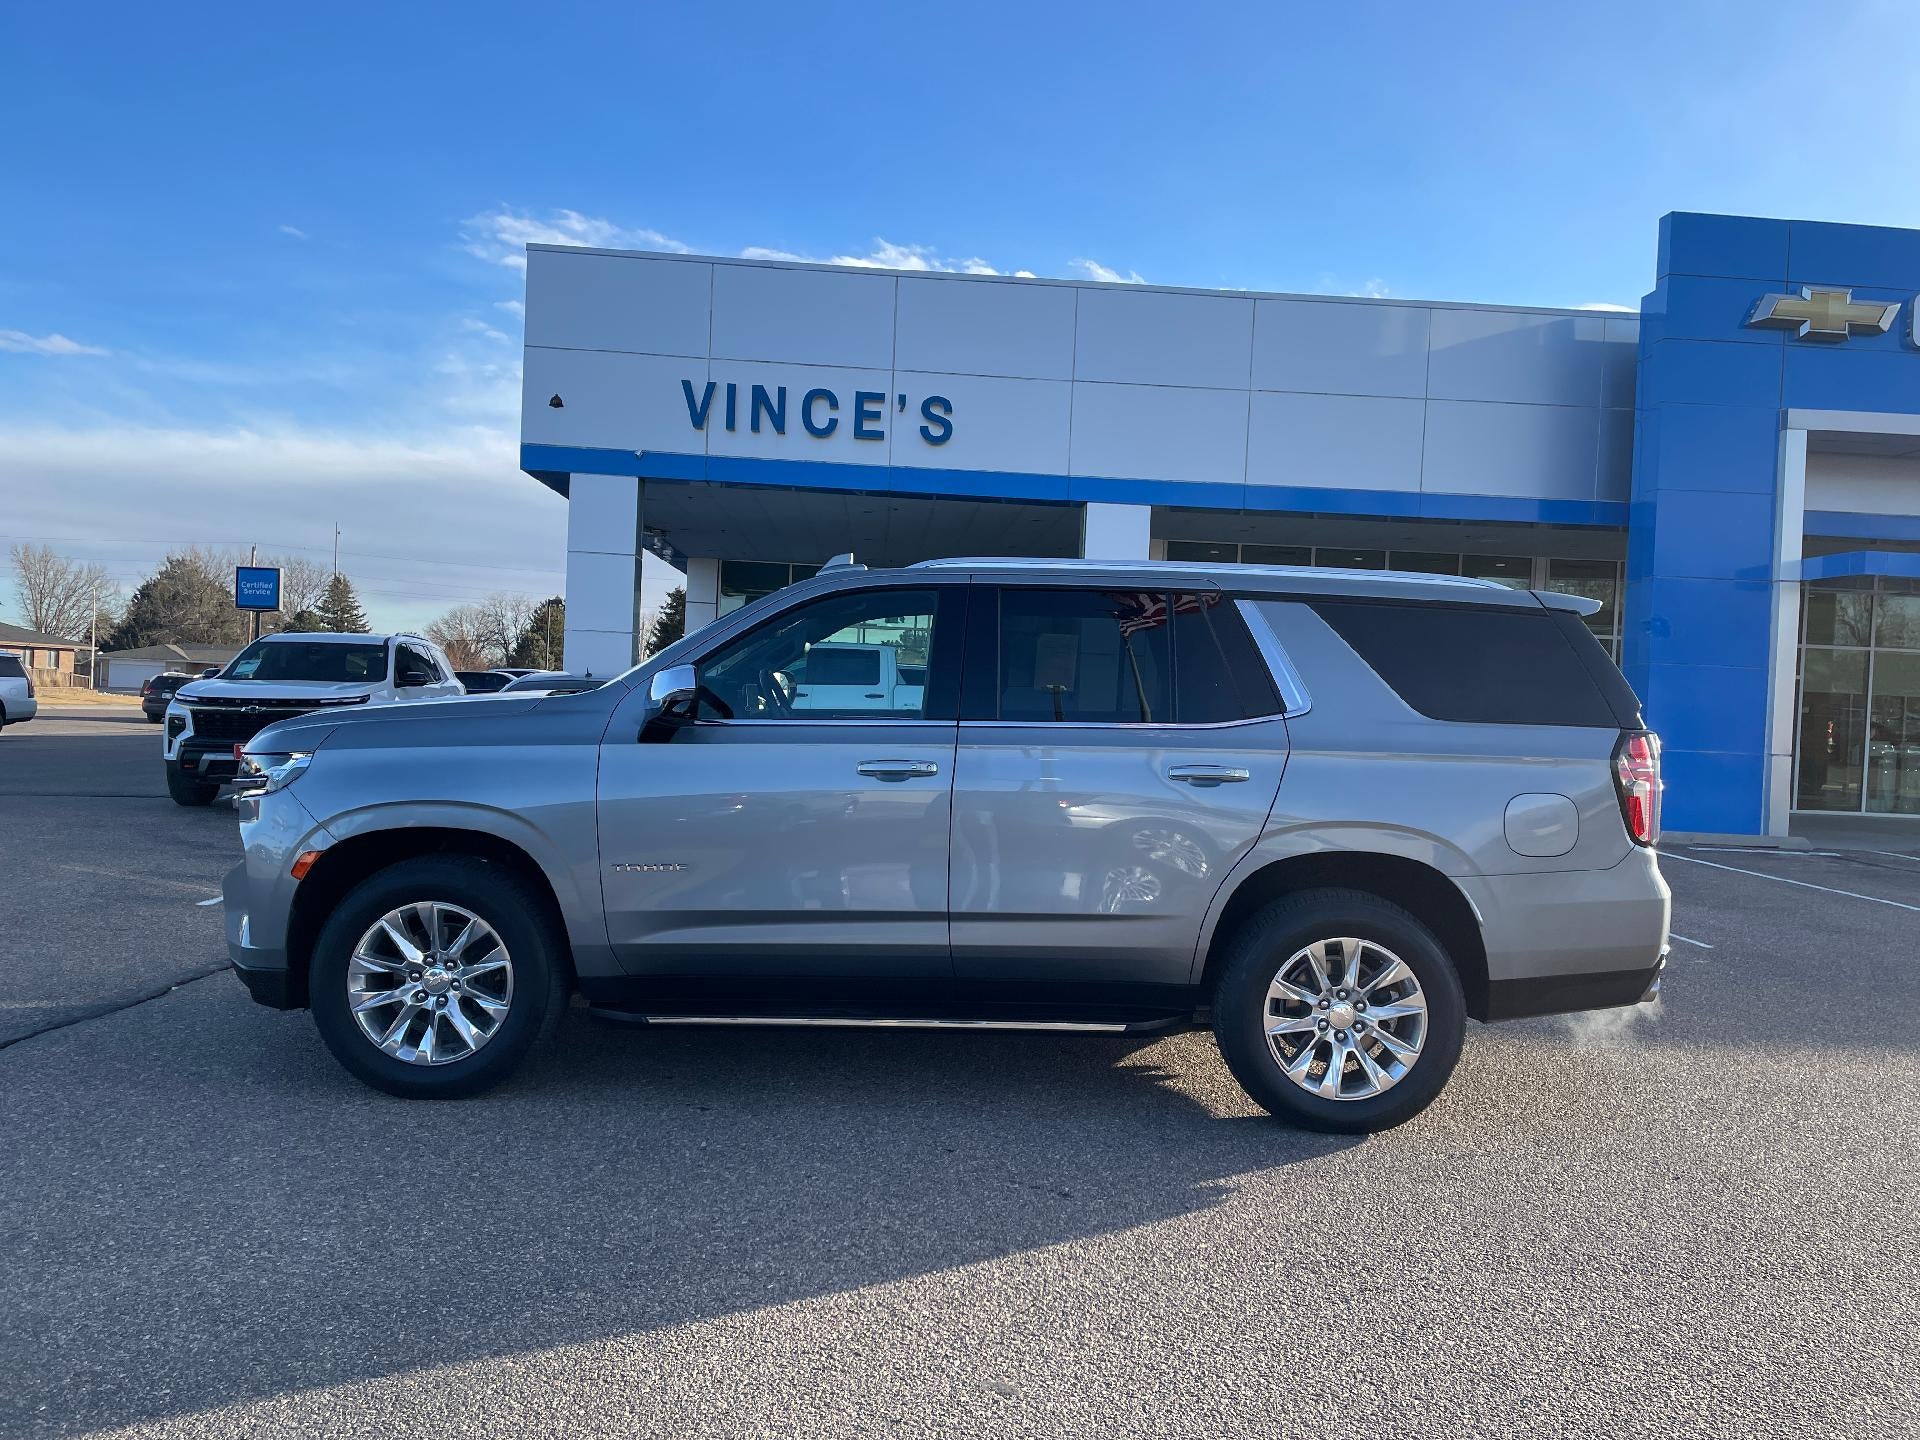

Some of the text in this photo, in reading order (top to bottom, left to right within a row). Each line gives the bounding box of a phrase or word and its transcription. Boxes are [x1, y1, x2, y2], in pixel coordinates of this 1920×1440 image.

[681, 379, 953, 446] VINCE'S
[241, 581, 273, 589] Certified
[611, 863, 689, 873] TAHOE
